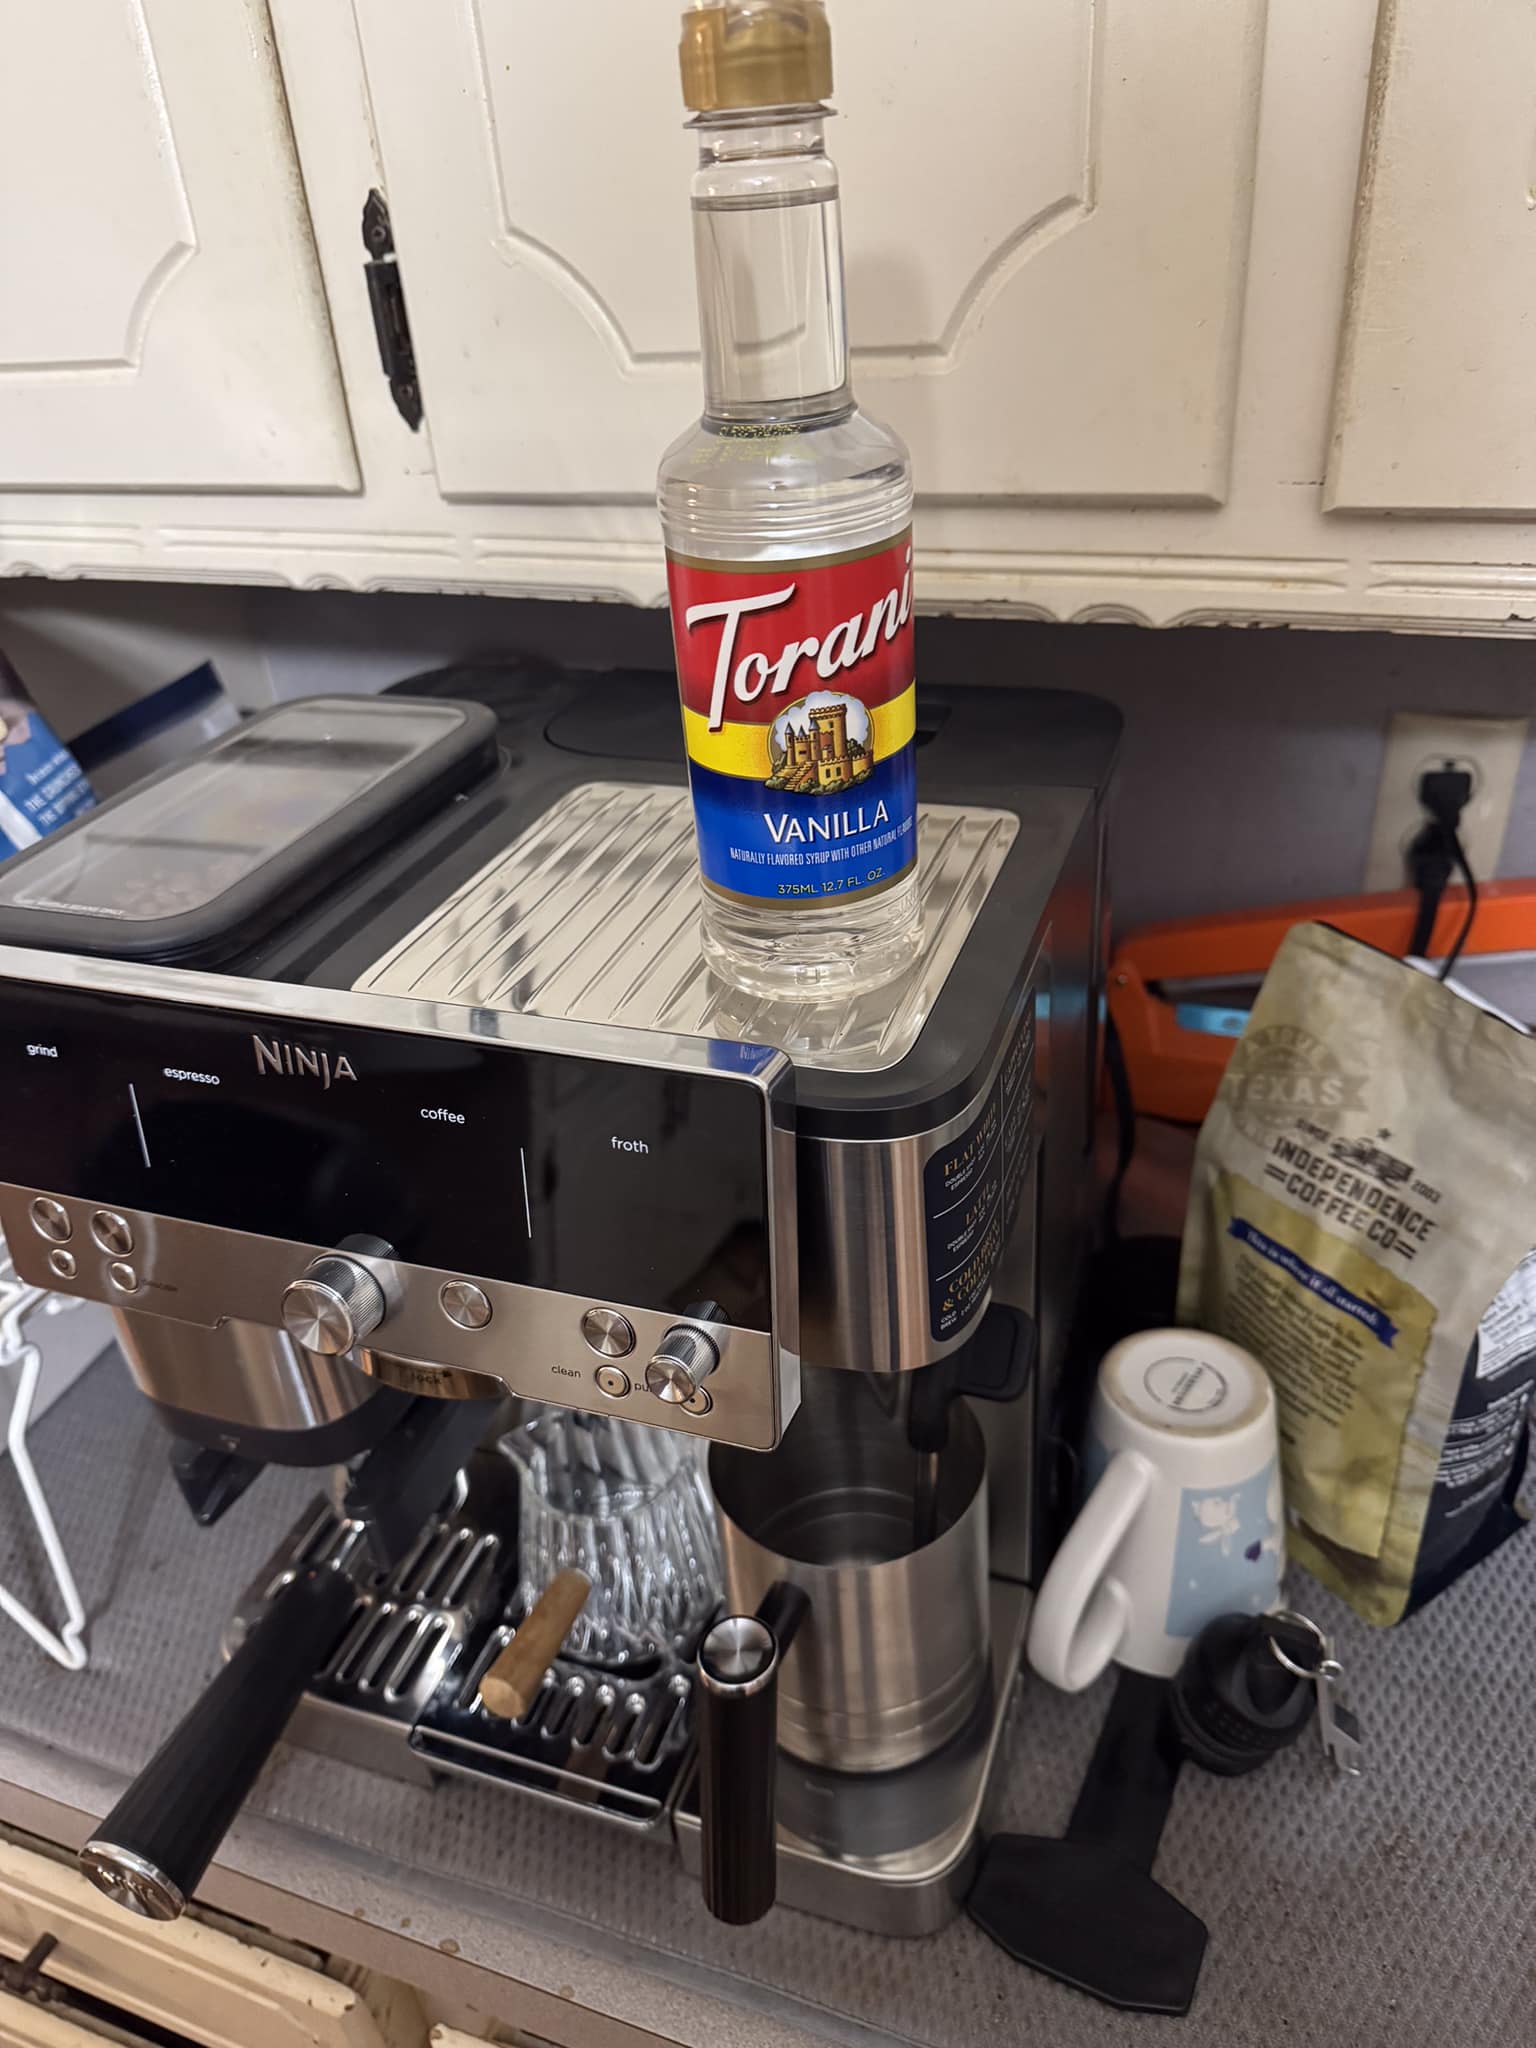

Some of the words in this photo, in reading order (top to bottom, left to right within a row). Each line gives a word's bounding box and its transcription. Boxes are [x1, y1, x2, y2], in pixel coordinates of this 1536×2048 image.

[685, 545, 913, 732] Torani
[763, 800, 889, 844] VANILLA
[730, 847, 766, 865] NATURALLY
[767, 852, 804, 866] FLAVORED
[806, 852, 830, 865] SYRUP
[830, 847, 850, 863] WITH
[851, 840, 872, 858] OTHER
[778, 884, 818, 895] 375ML
[822, 879, 844, 892] 12.7
[847, 873, 865, 888] FL.
[867, 867, 886, 881] OZ.
[26, 1042, 59, 1058] grind
[252, 1033, 359, 1090] NINJA
[163, 1067, 221, 1086] espresso
[1225, 1072, 1342, 1106] TEXAS
[420, 1106, 466, 1124] coffee
[611, 1136, 650, 1154] froth
[1271, 1135, 1438, 1242] INDEPENDENCE
[1286, 1173, 1370, 1232] COFFEE
[1367, 1219, 1398, 1250] CO
[551, 1365, 582, 1379] clean
